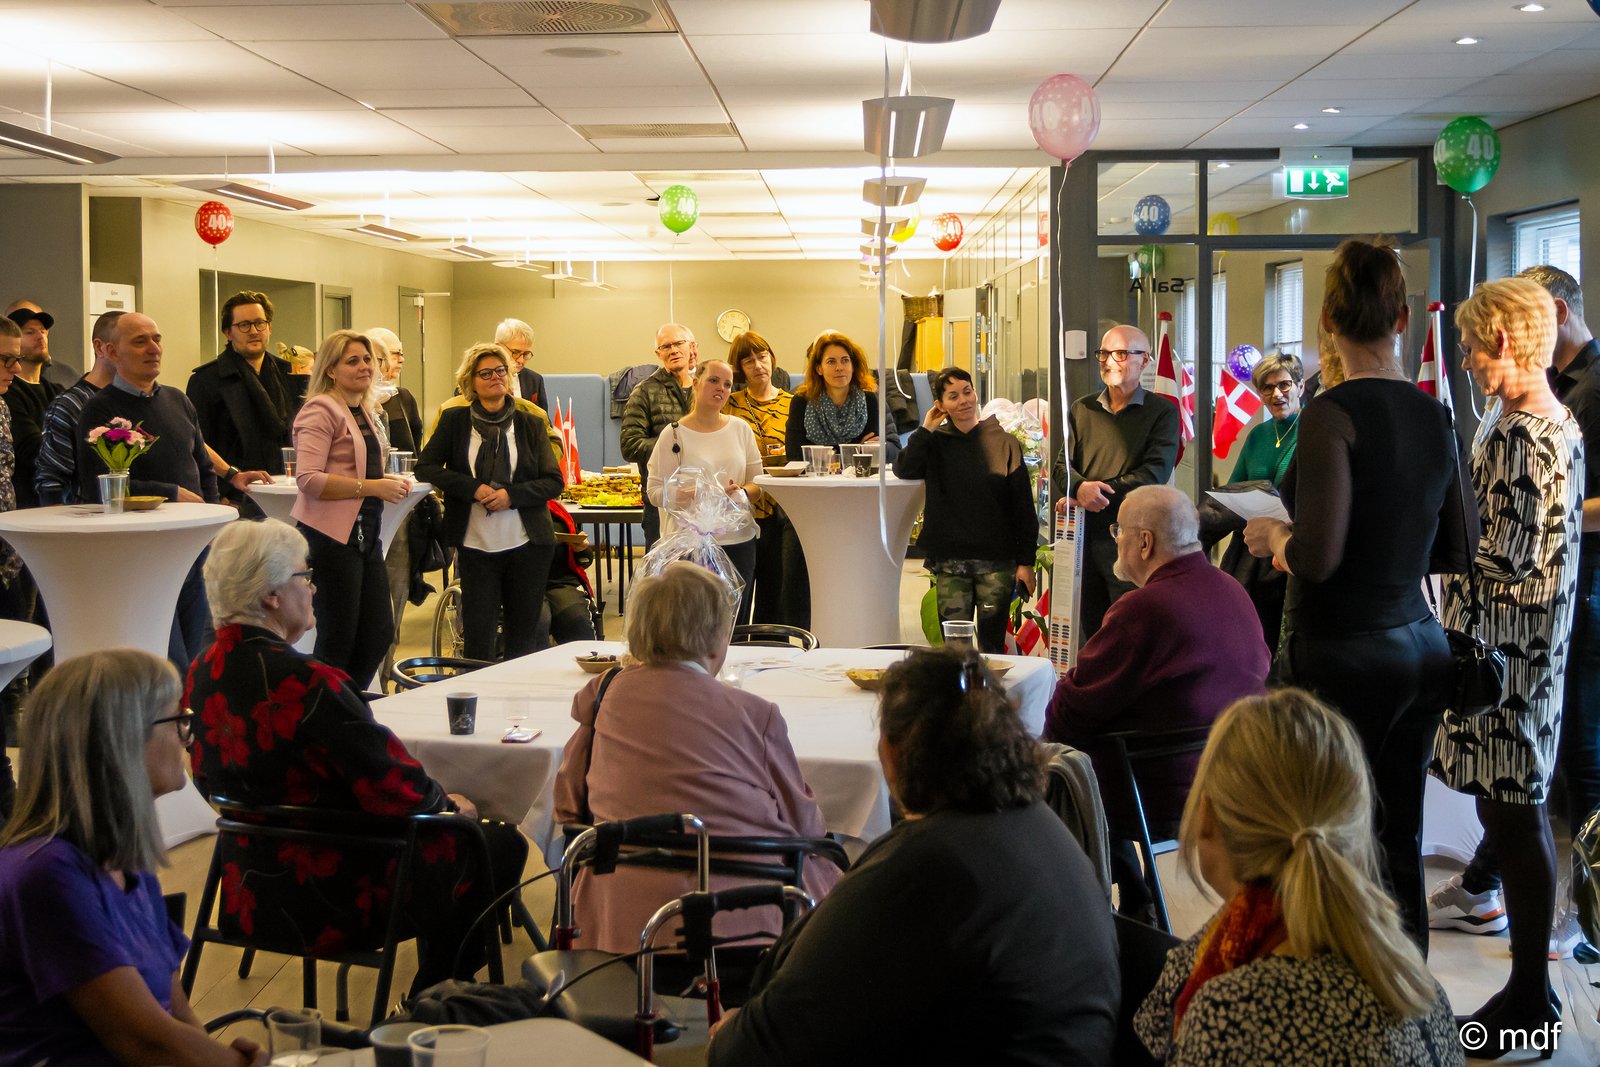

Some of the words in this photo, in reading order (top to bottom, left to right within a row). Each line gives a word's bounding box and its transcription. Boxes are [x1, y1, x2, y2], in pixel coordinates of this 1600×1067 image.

[1467, 133, 1495, 160] 40
[676, 197, 695, 215] 40
[1140, 205, 1159, 222] 40
[208, 213, 227, 230] 40
